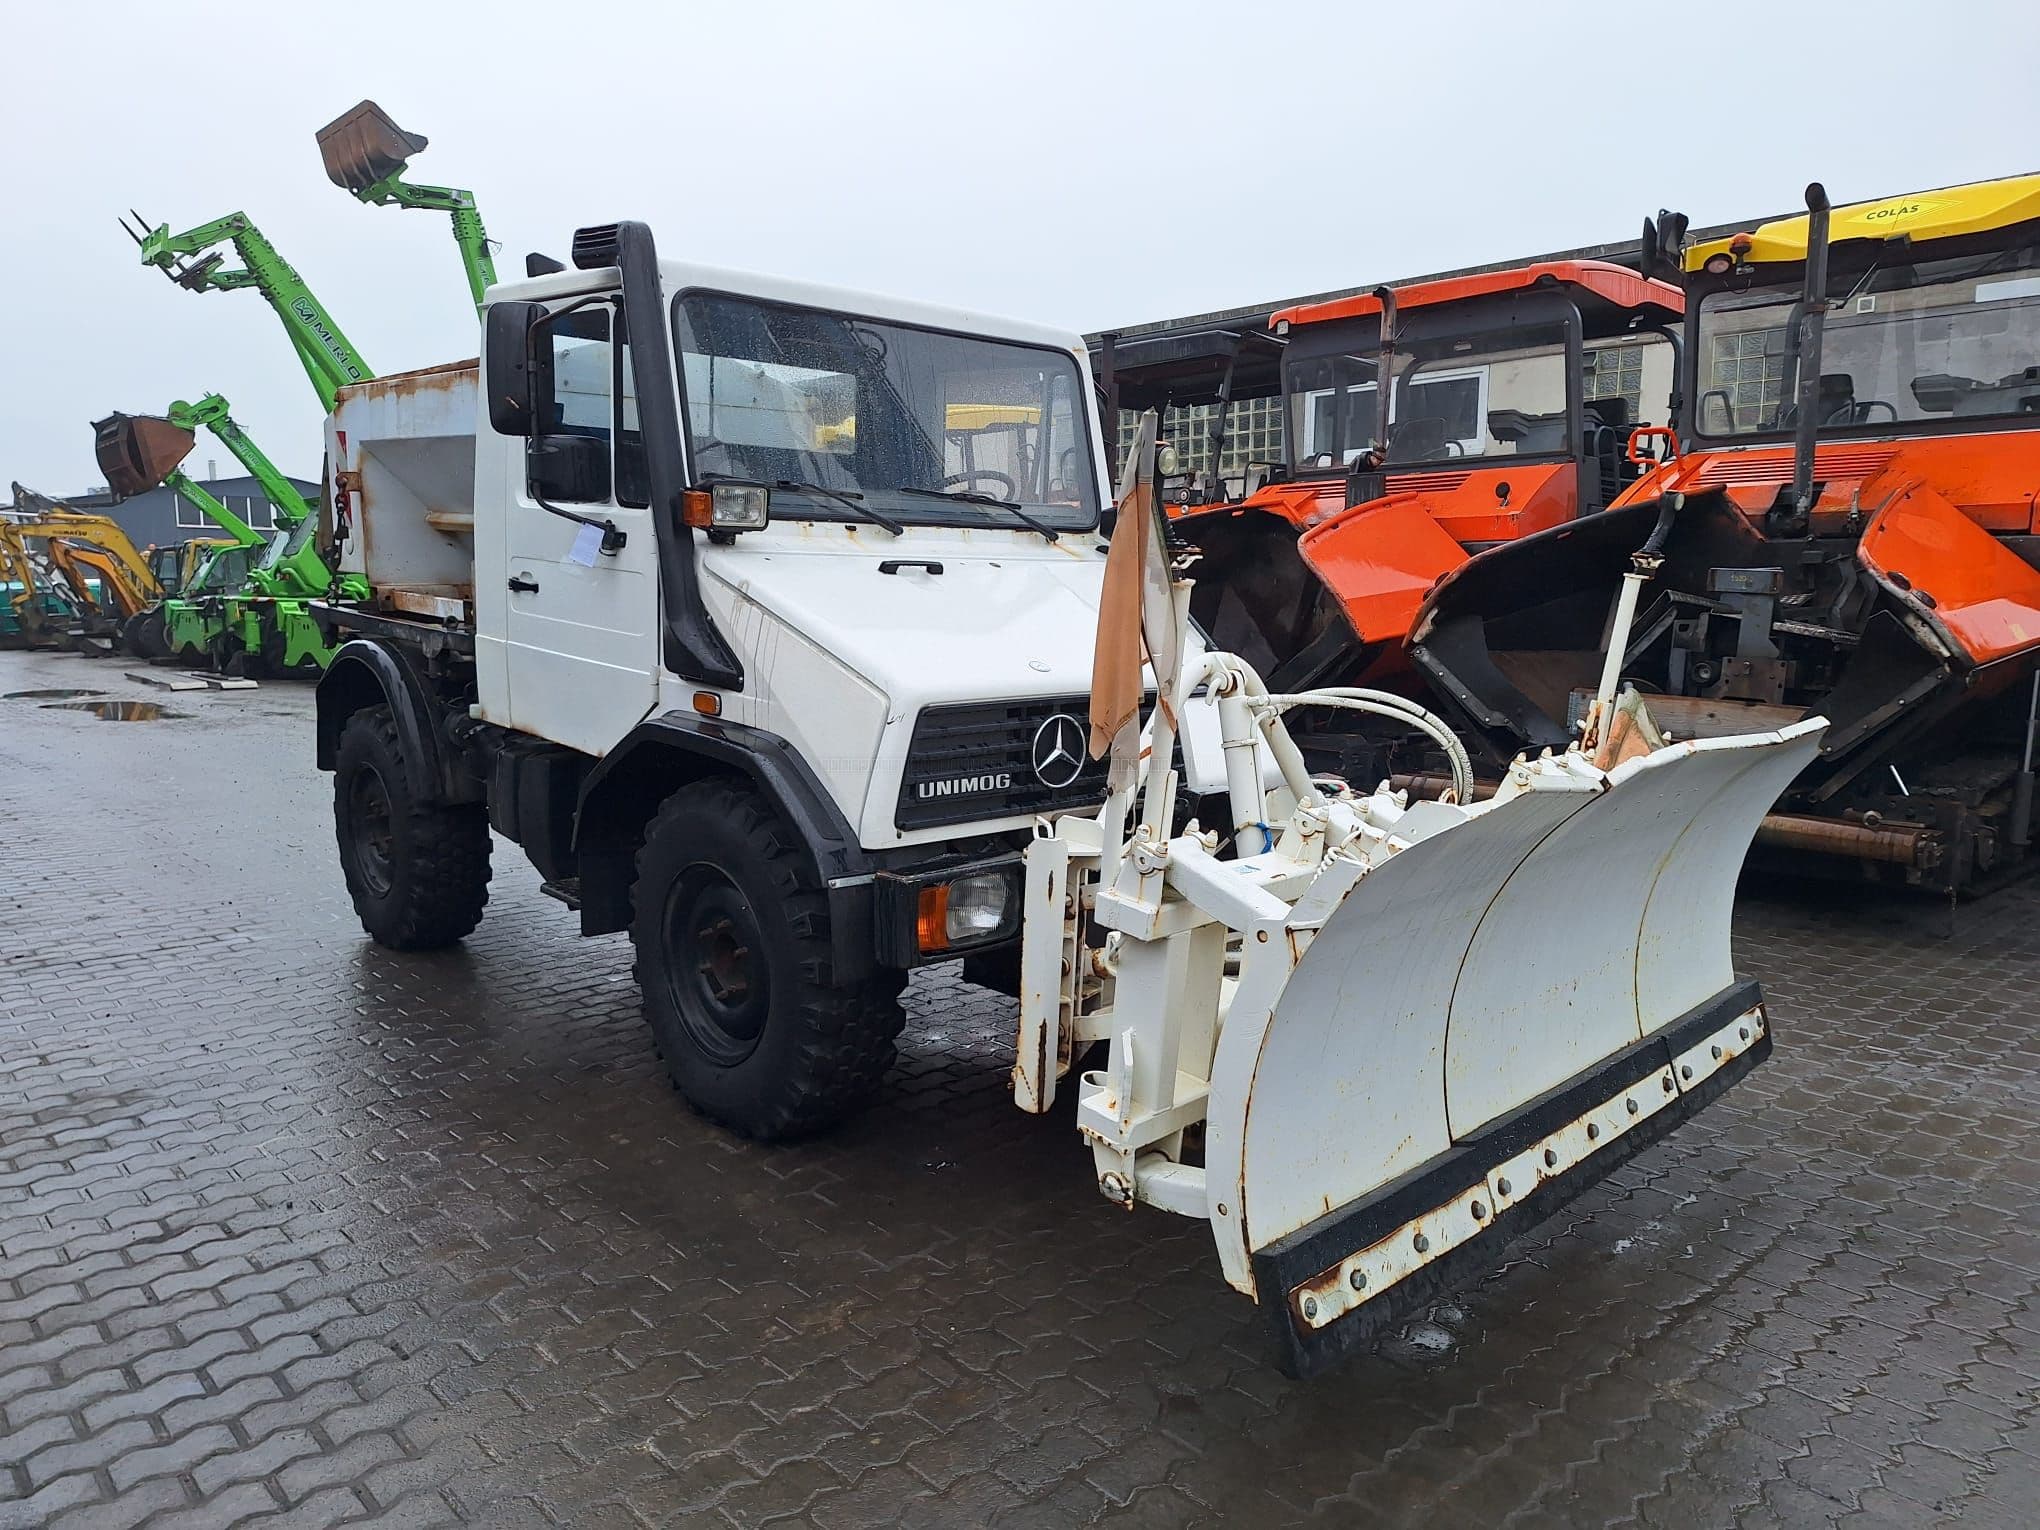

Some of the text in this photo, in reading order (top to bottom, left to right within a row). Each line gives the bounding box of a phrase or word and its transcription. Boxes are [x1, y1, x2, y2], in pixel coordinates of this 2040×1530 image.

[1866, 204, 1920, 220] COLAS
[313, 321, 362, 380] MERLO
[919, 773, 1011, 798] UNIMOG
